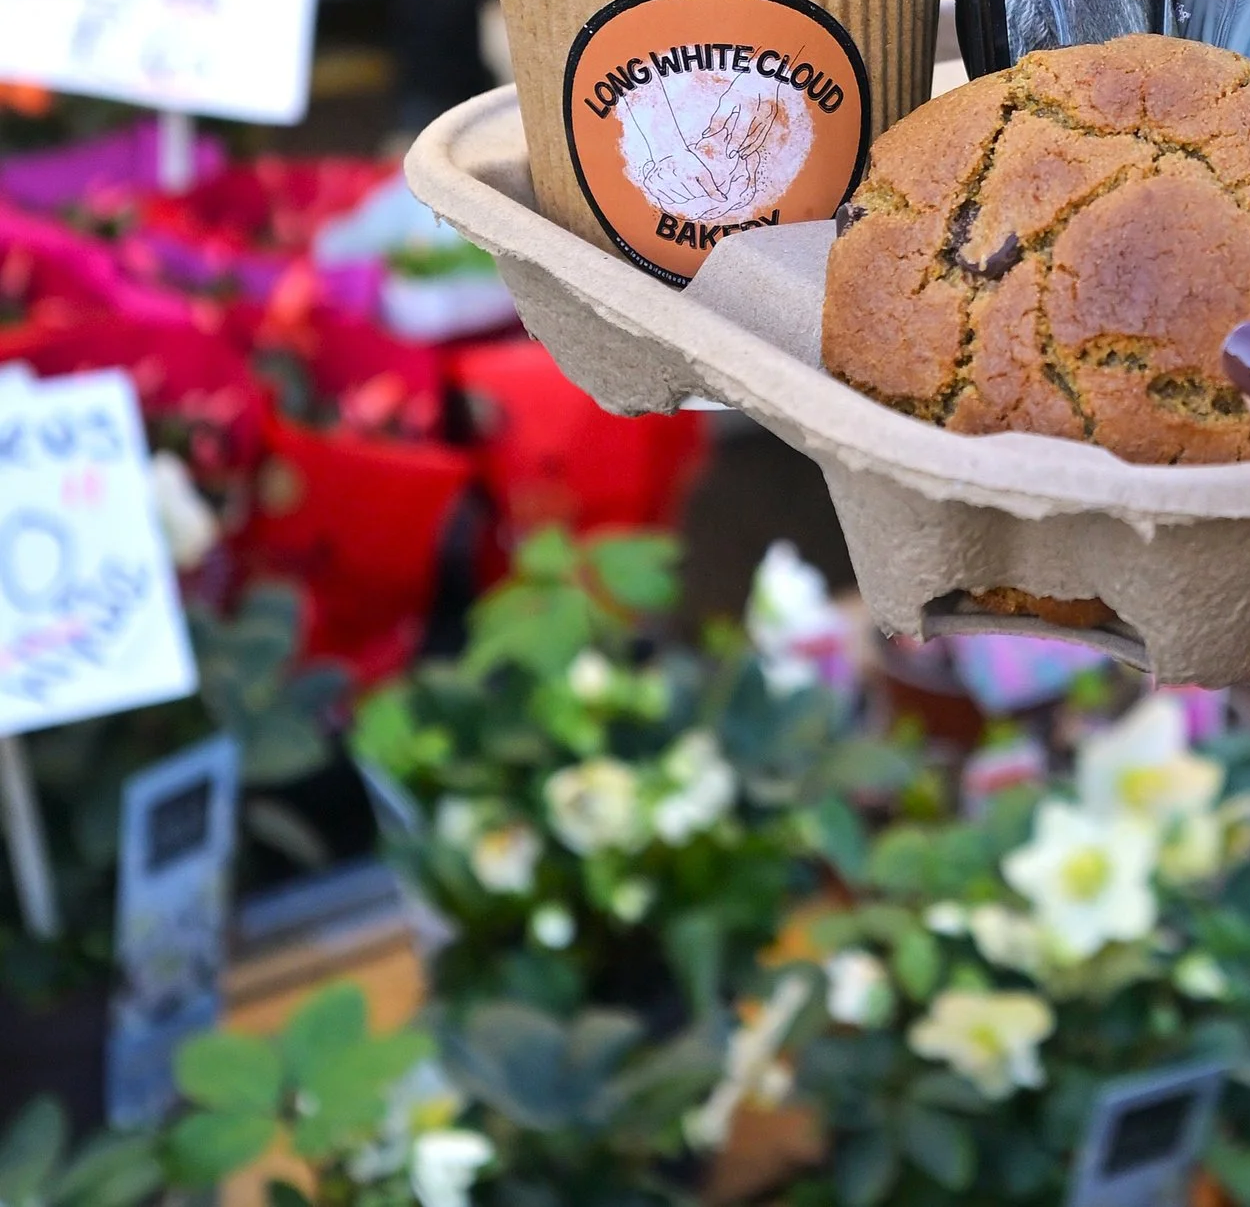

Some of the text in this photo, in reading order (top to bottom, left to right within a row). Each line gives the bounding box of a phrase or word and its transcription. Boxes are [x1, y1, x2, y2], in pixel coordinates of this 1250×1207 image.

[585, 43, 845, 119] LONG WHITE CLOUD
